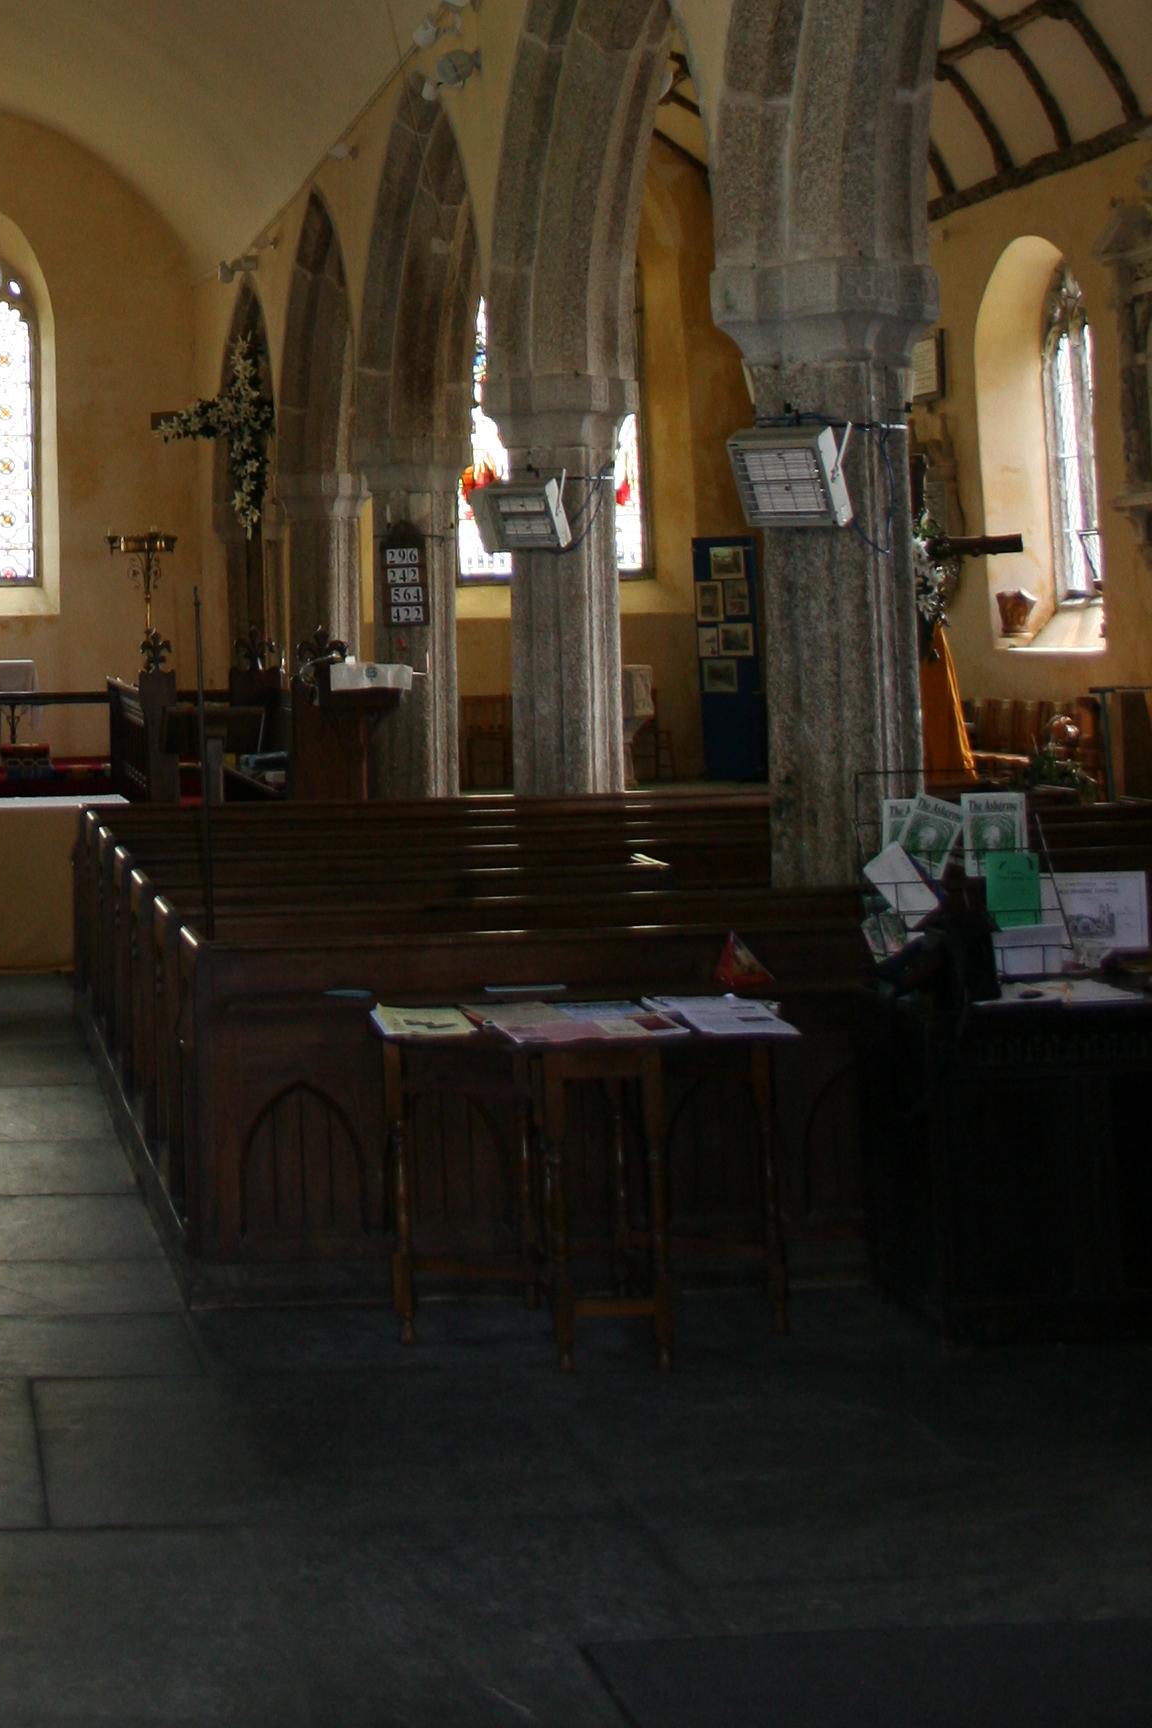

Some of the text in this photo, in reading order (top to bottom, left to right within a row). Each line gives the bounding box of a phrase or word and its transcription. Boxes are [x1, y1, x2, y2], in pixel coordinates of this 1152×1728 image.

[388, 549, 417, 563] 296
[389, 568, 417, 582] 242
[393, 588, 421, 602] 564
[393, 607, 422, 621] 422
[968, 800, 982, 811] The
